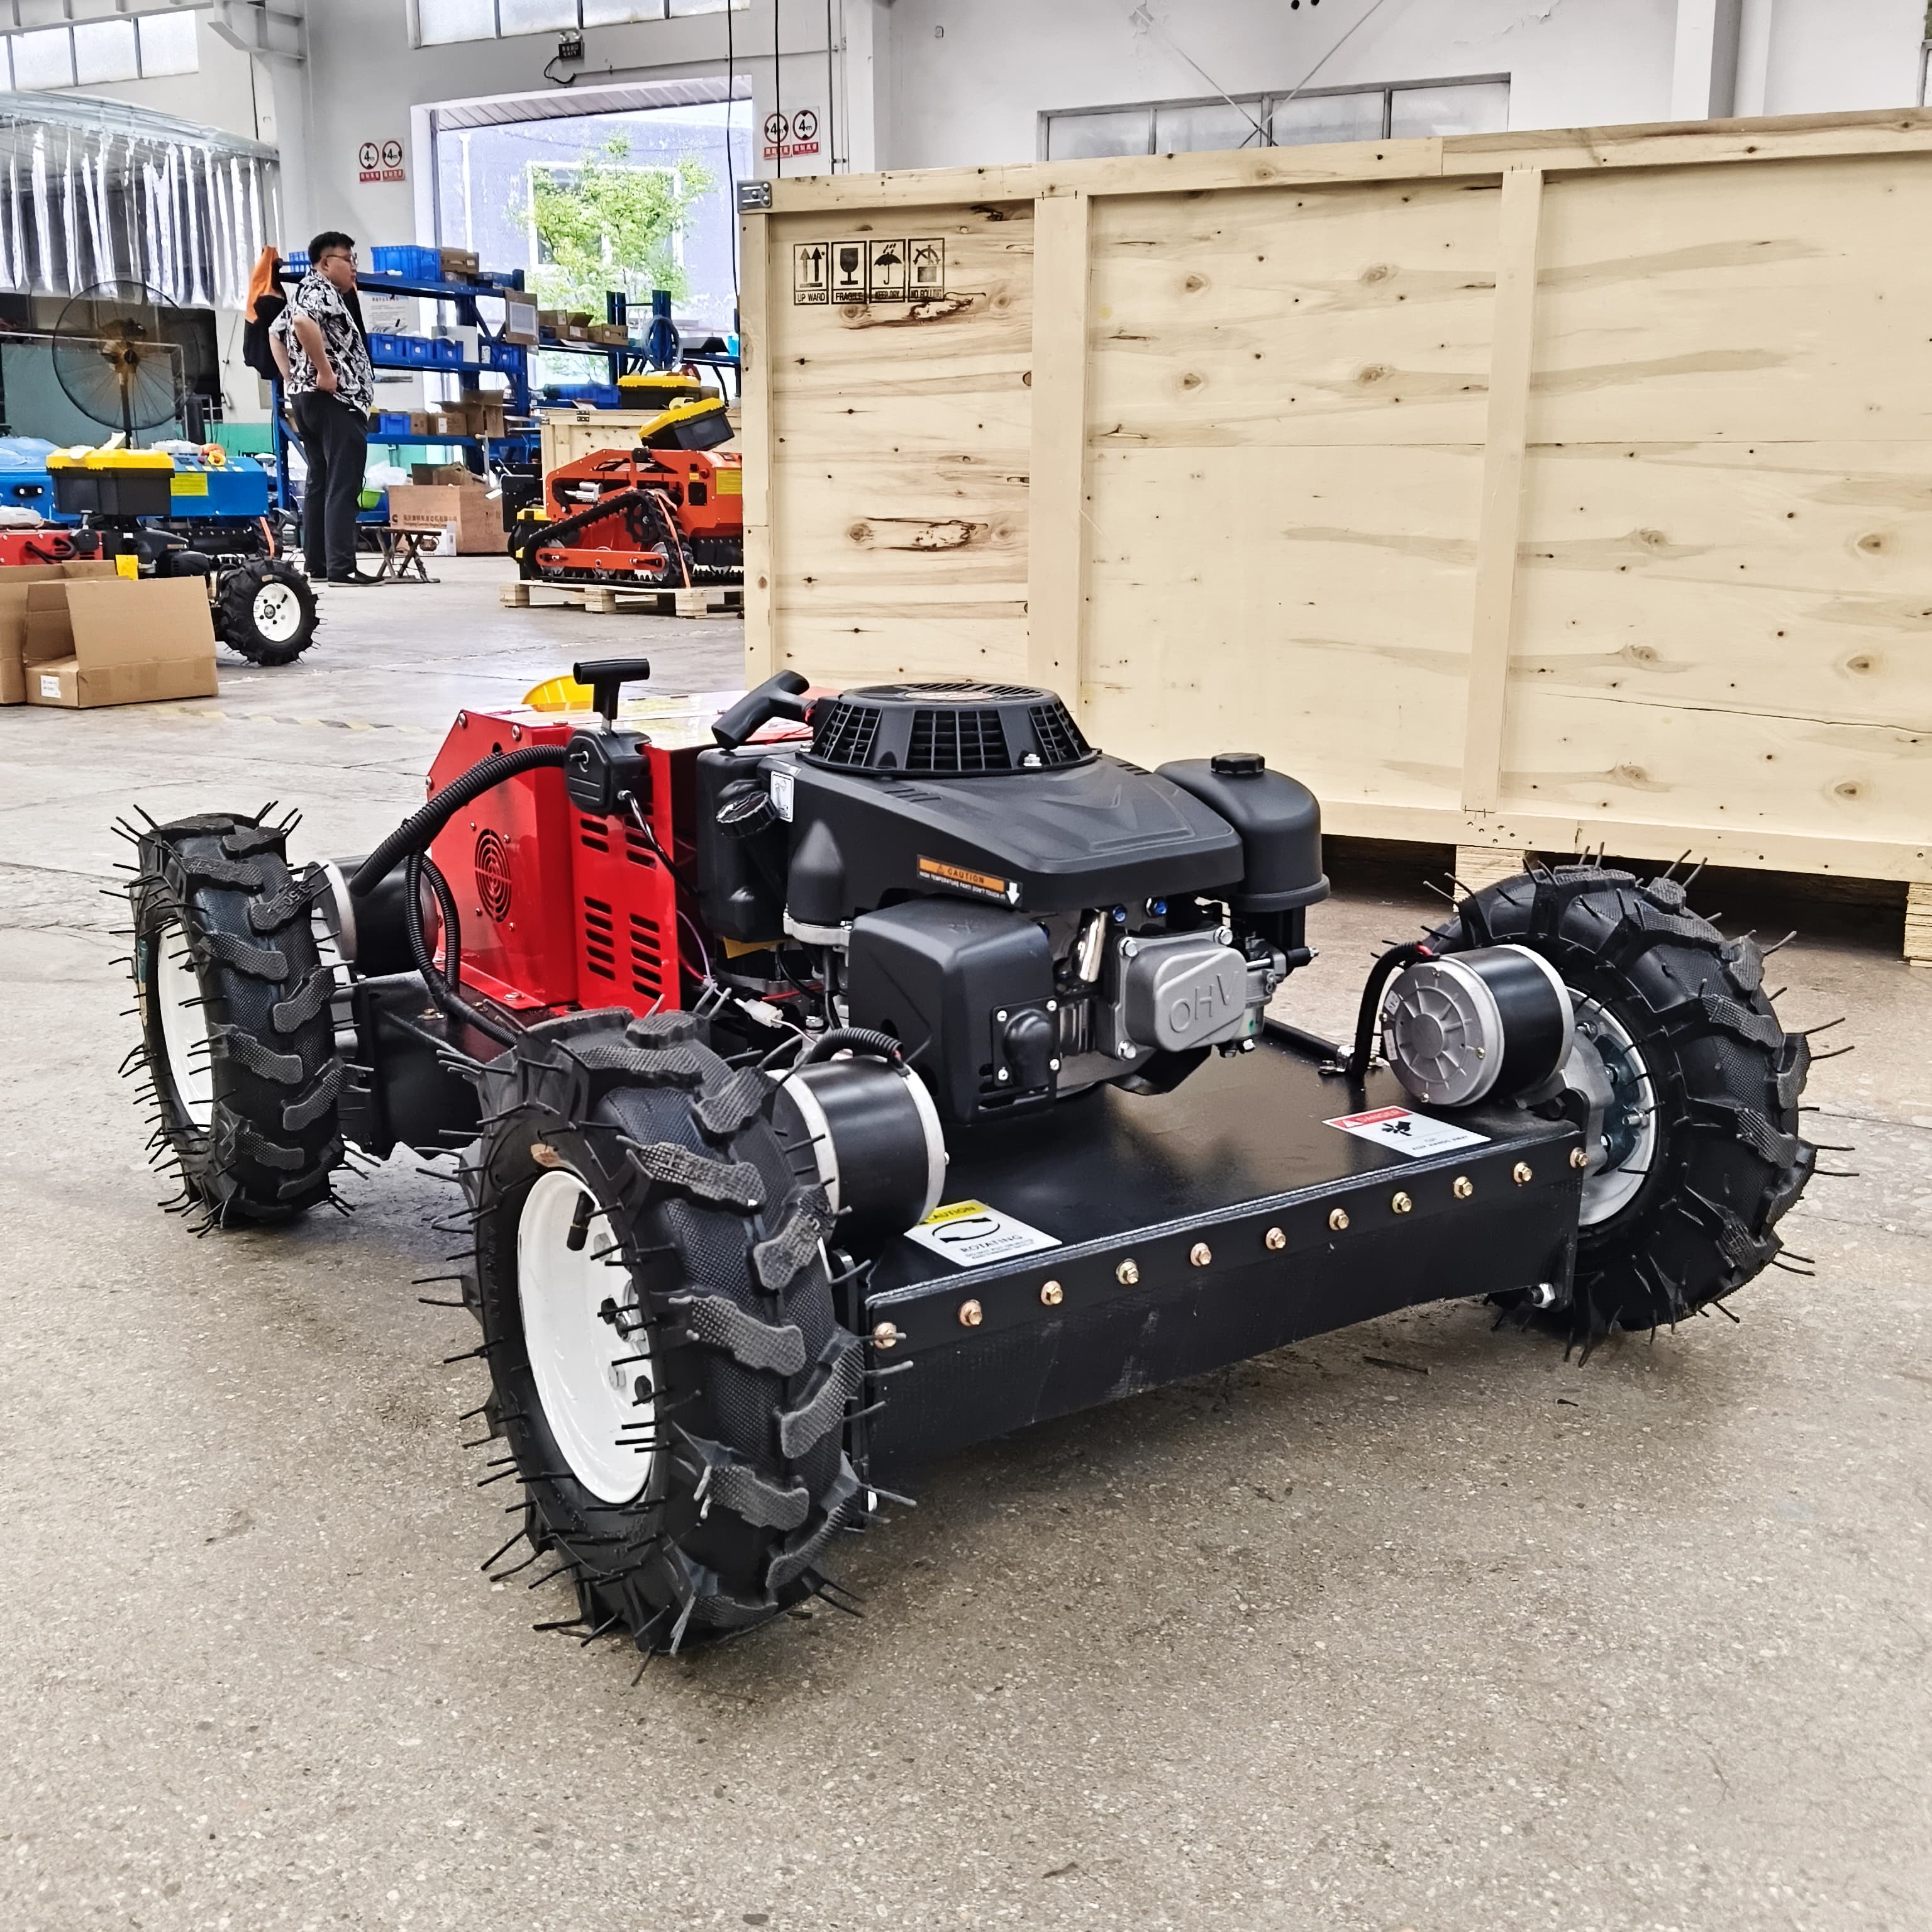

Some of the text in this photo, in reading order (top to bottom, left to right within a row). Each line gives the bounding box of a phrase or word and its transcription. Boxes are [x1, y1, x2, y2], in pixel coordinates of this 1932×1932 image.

[808, 292, 826, 301] WARD
[947, 869, 985, 884] CAUTION
[1169, 970, 1240, 1033] OHV
[1358, 1109, 1402, 1123] DANGER
[960, 1235, 1023, 1252] ROTATING
